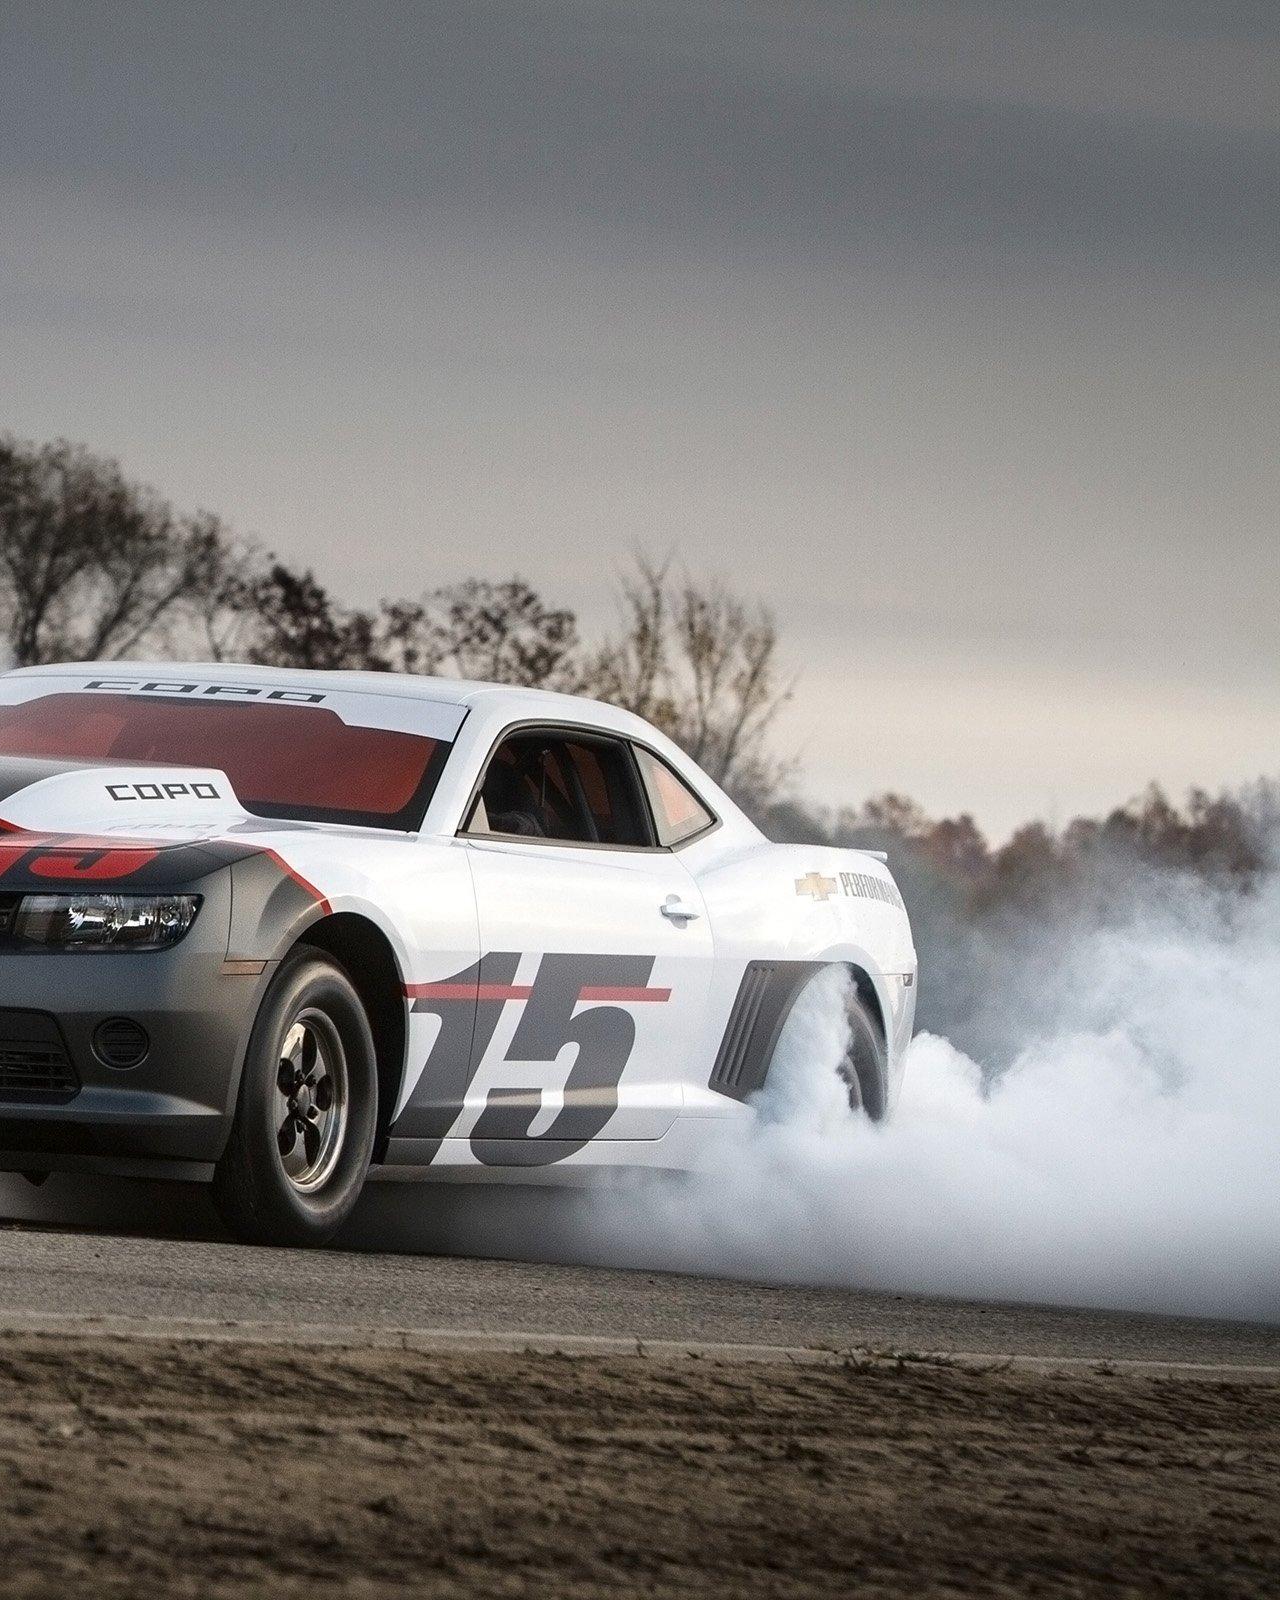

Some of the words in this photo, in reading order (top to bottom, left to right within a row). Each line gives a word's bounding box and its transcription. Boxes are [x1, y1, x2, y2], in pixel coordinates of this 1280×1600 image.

[83, 681, 327, 703] COPO
[104, 783, 221, 801] COPO
[383, 951, 658, 1168] 15
